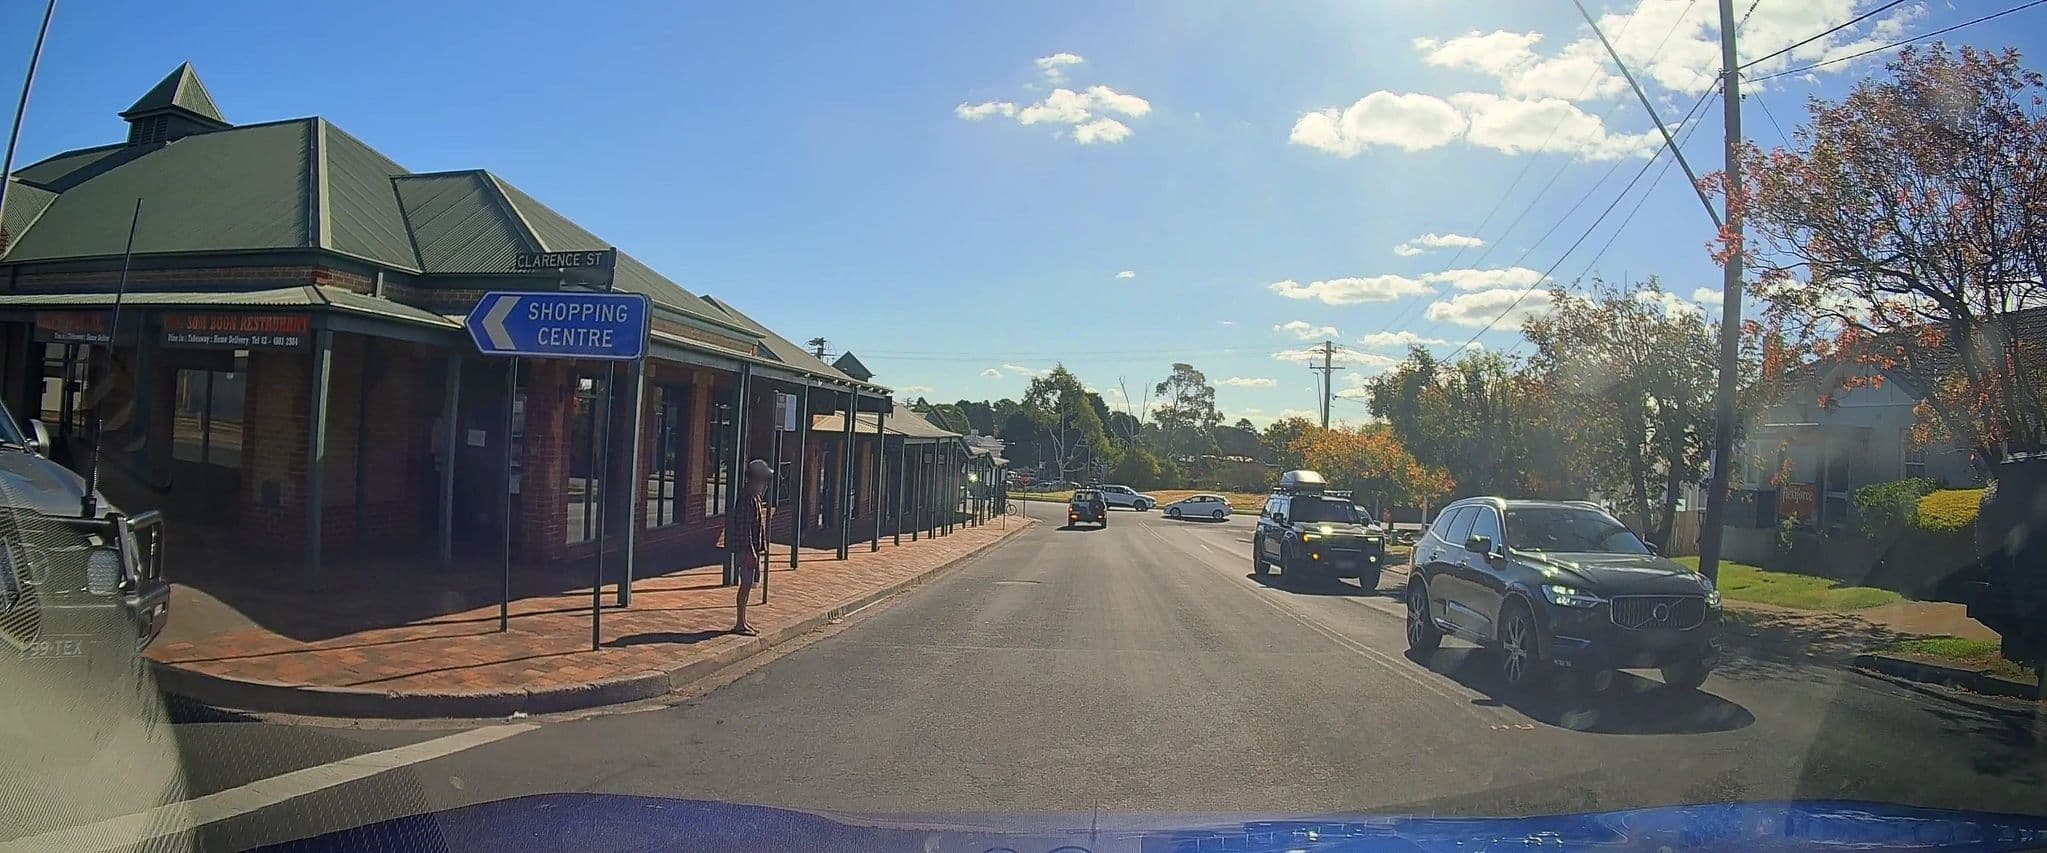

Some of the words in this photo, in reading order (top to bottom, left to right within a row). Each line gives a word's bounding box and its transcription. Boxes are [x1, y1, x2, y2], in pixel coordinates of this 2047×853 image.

[517, 252, 581, 268] CLARENCE
[586, 252, 603, 266] ST
[528, 302, 628, 322] SHOPPING
[240, 315, 309, 333] RESTAURANT
[538, 327, 614, 348] CENTRE
